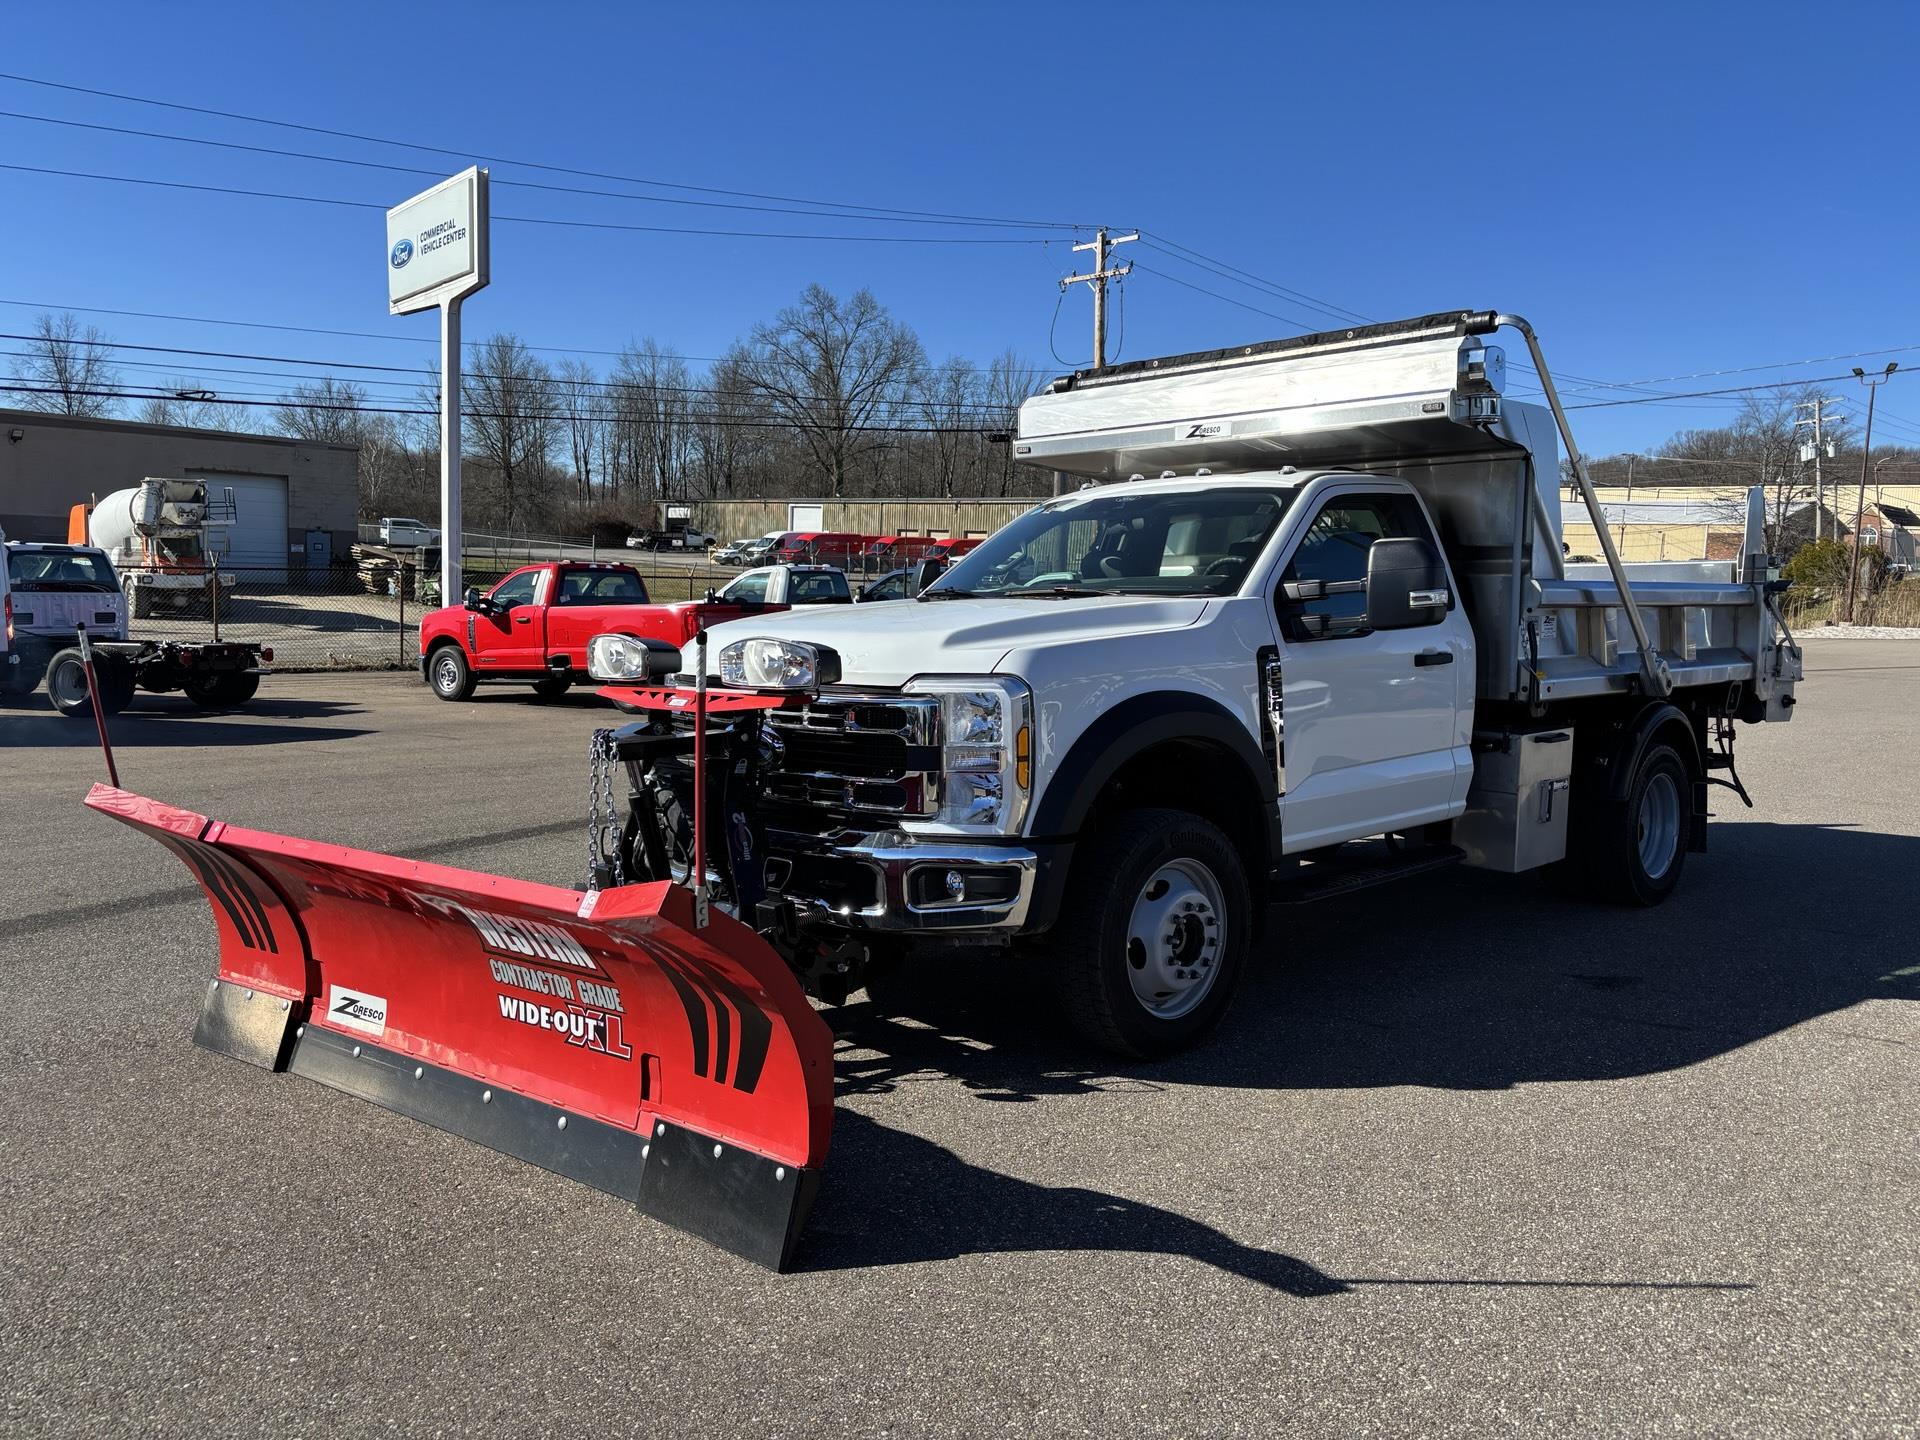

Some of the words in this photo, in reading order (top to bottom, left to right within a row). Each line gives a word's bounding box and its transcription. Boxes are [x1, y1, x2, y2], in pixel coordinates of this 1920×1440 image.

[420, 218, 456, 243] COMMERCIAL
[420, 237, 442, 256] VEHICLE
[442, 228, 466, 246] CENTER
[393, 243, 410, 265] Ford
[1186, 424, 1221, 438] ZORESCO
[464, 908, 597, 970] WESTERN
[489, 958, 576, 1001] CONTRACTOR
[576, 978, 625, 1013] GRADE
[331, 996, 385, 1022] ZORESCO
